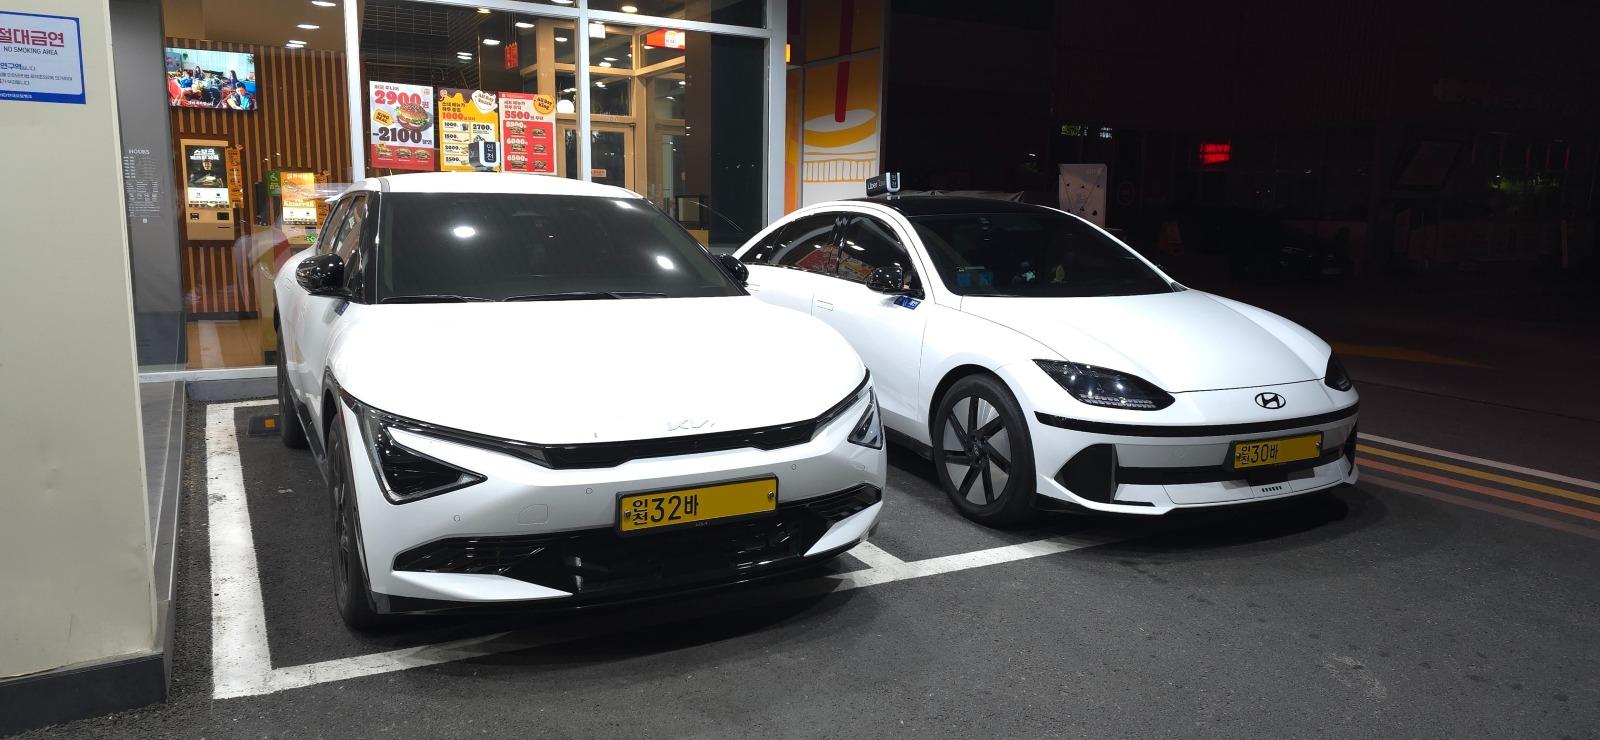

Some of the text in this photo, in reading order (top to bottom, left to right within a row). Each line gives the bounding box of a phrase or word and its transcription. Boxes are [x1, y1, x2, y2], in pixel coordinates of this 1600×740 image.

[0, 27, 64, 47] 절대금연
[13, 46, 42, 55] SMOKING
[42, 48, 58, 56] AREA
[868, 182, 878, 190] Uber
[632, 499, 648, 526] 인천
